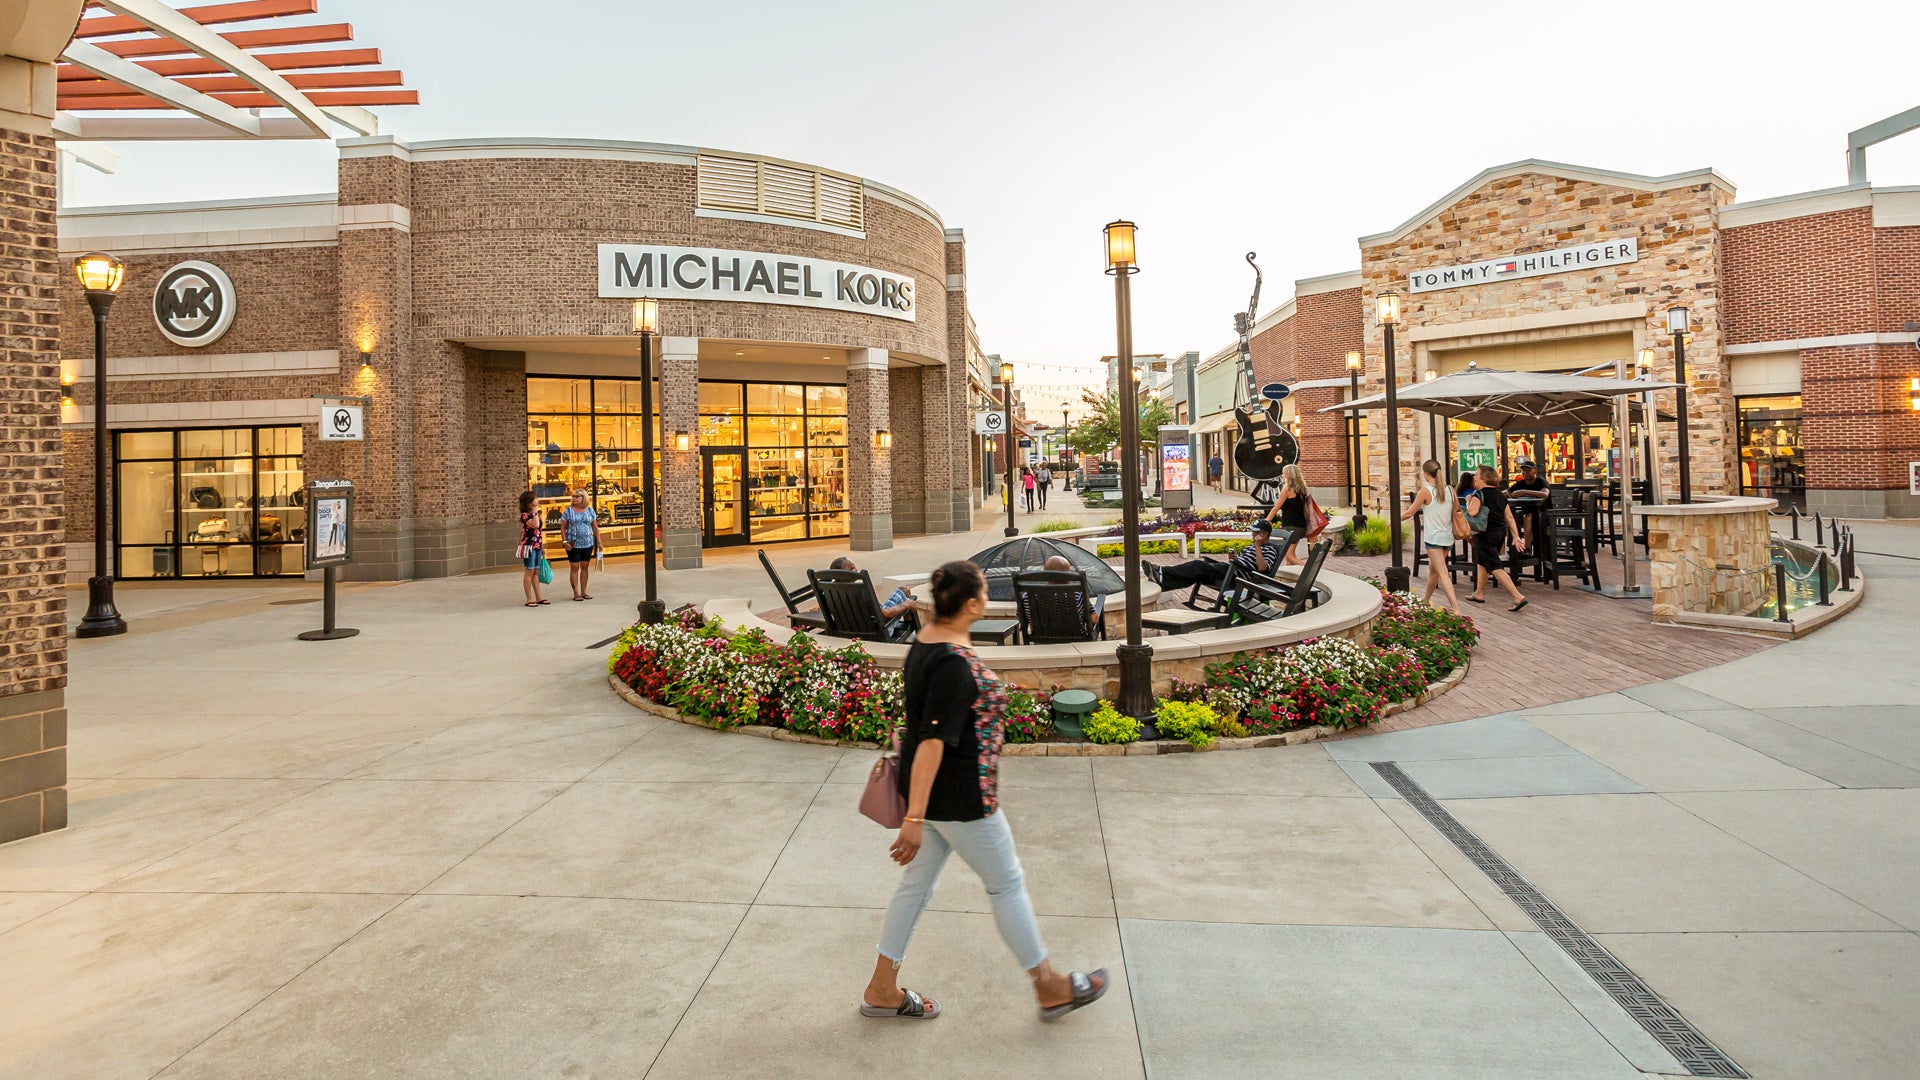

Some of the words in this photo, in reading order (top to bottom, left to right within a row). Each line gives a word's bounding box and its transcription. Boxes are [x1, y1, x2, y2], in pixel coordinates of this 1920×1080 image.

[614, 251, 822, 298] MICHAEL
[837, 269, 914, 312] KORS
[1412, 265, 1490, 288] TOMMY
[1524, 244, 1632, 271] HILFIGER
